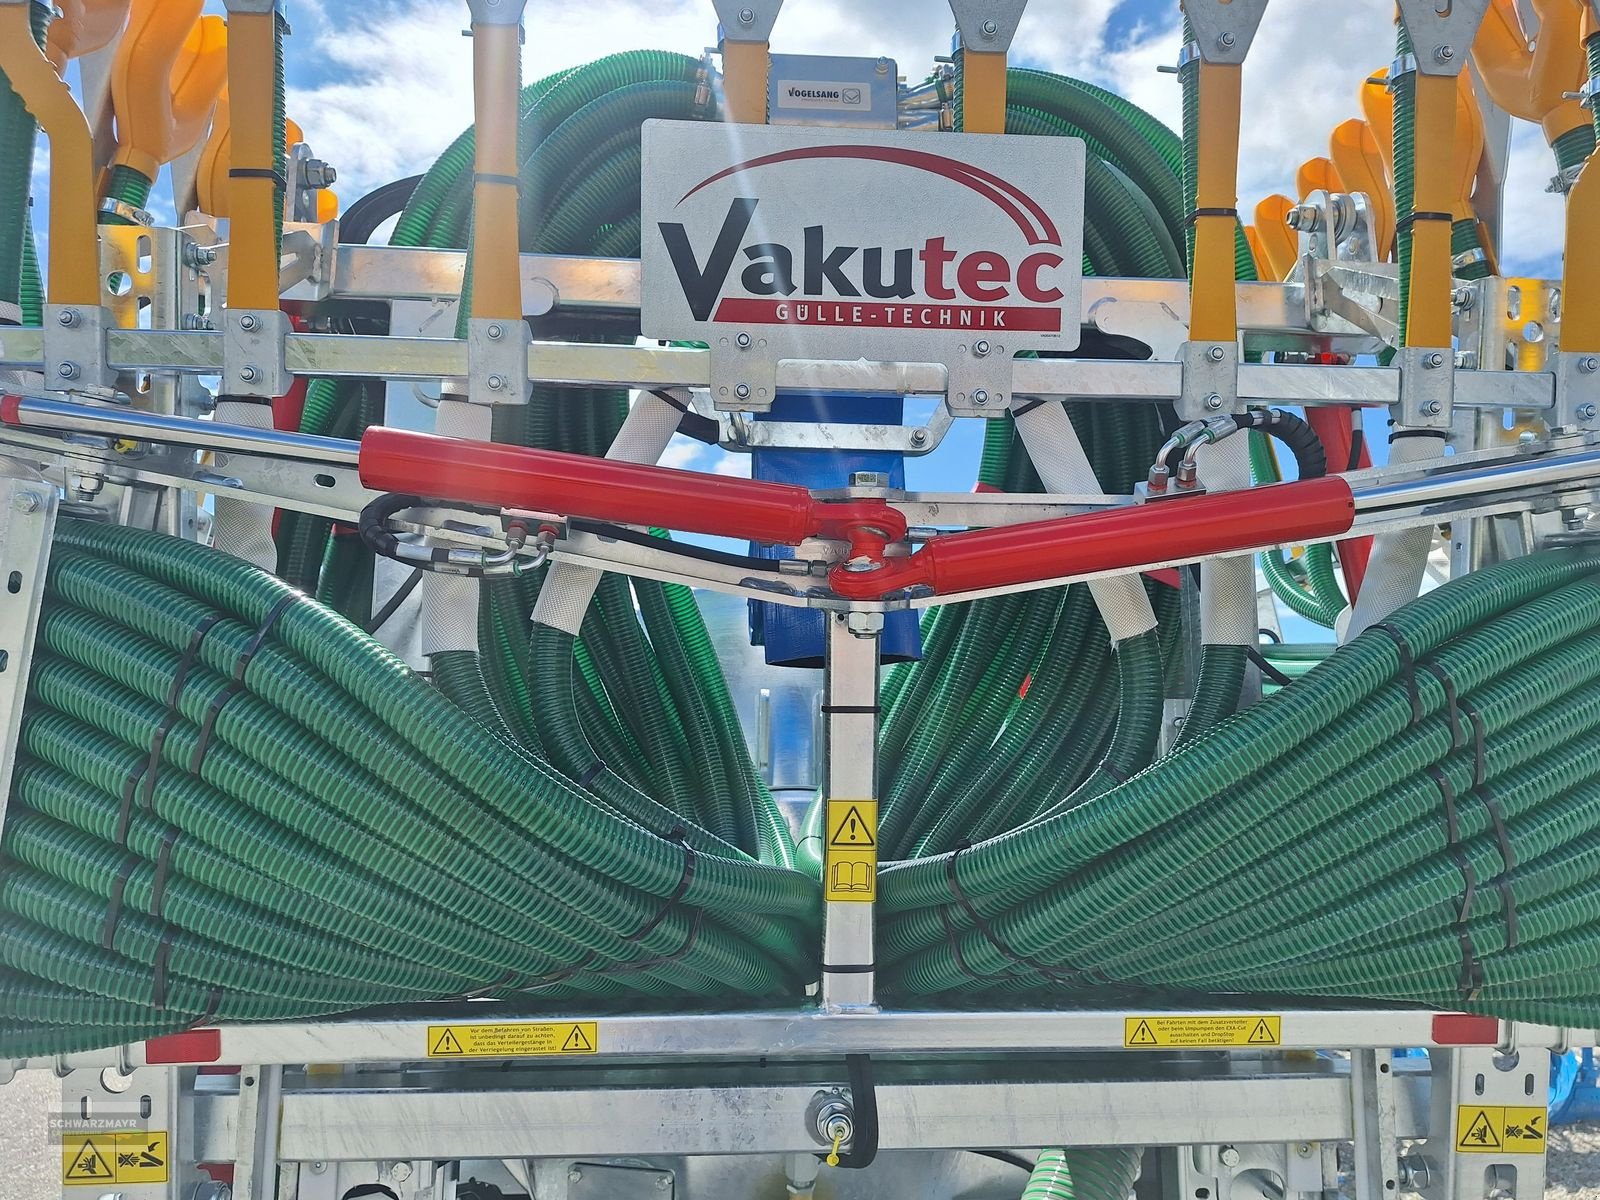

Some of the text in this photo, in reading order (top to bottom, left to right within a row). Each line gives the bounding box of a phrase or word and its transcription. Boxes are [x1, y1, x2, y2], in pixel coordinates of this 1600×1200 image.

[788, 87, 839, 99] VOGELSANG
[657, 197, 1065, 322] Vakutec
[775, 303, 1007, 327] GÜLLE-TECHNIK
